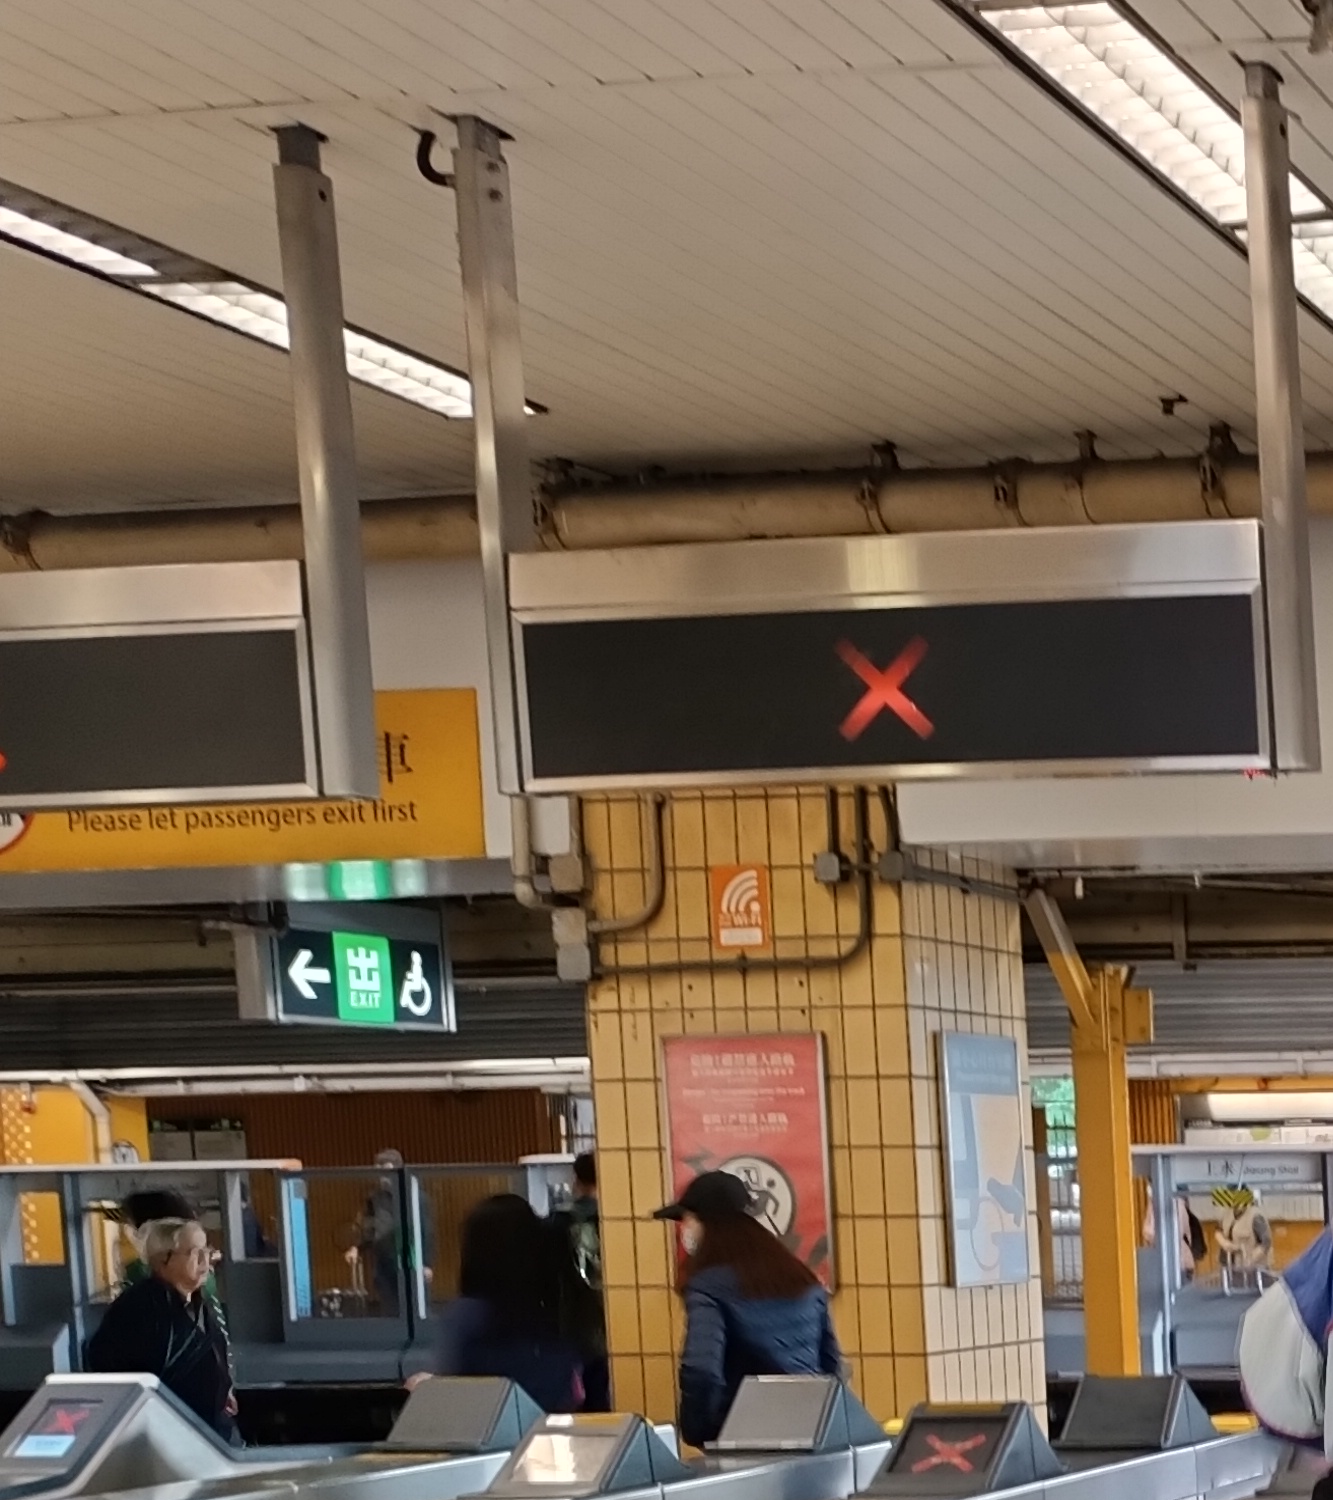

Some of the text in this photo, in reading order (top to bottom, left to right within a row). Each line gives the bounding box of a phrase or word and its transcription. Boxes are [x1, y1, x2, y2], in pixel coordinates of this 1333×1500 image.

[66, 799, 417, 834] Please let passengers exit first
[346, 946, 381, 991] 出
[350, 991, 381, 1009] EXIT
